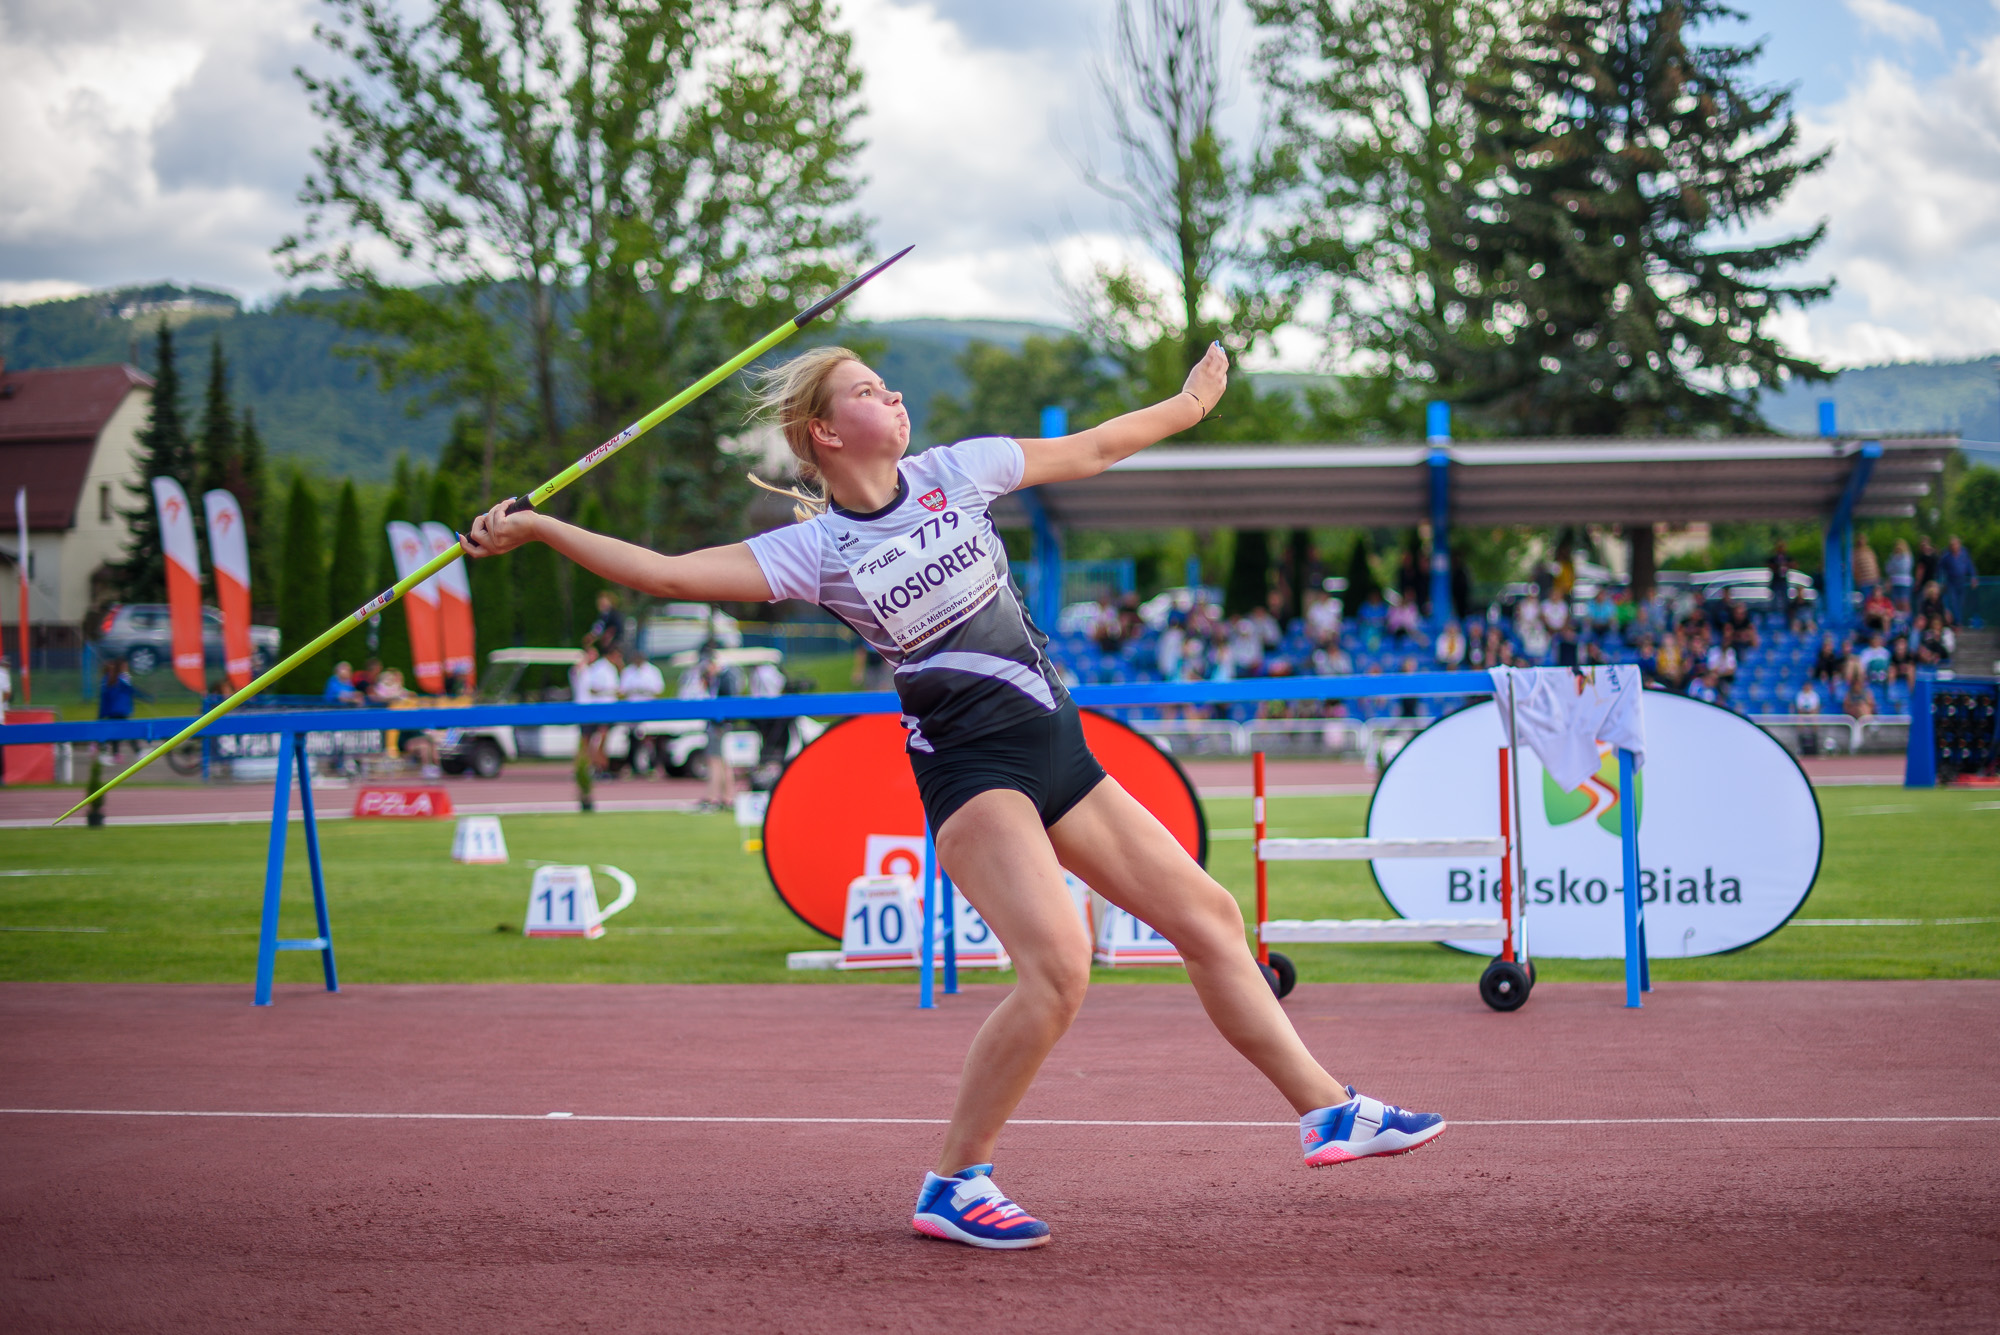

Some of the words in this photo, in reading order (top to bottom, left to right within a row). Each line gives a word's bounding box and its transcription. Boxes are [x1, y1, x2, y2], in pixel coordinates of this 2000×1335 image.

[838, 537, 859, 552] erima
[910, 511, 959, 550] 779
[868, 547, 906, 575] FUEL
[873, 535, 987, 619] KOSIOREK
[896, 634, 908, 643] 54.
[908, 621, 927, 636] PZLA
[927, 596, 968, 625] Mistrzostwa
[968, 582, 985, 598] Polski
[985, 573, 996, 585] U18
[360, 791, 433, 816] PZLA
[1449, 867, 1743, 904] Bielsko-Biała
[537, 888, 575, 922] 11
[852, 904, 904, 945] 10
